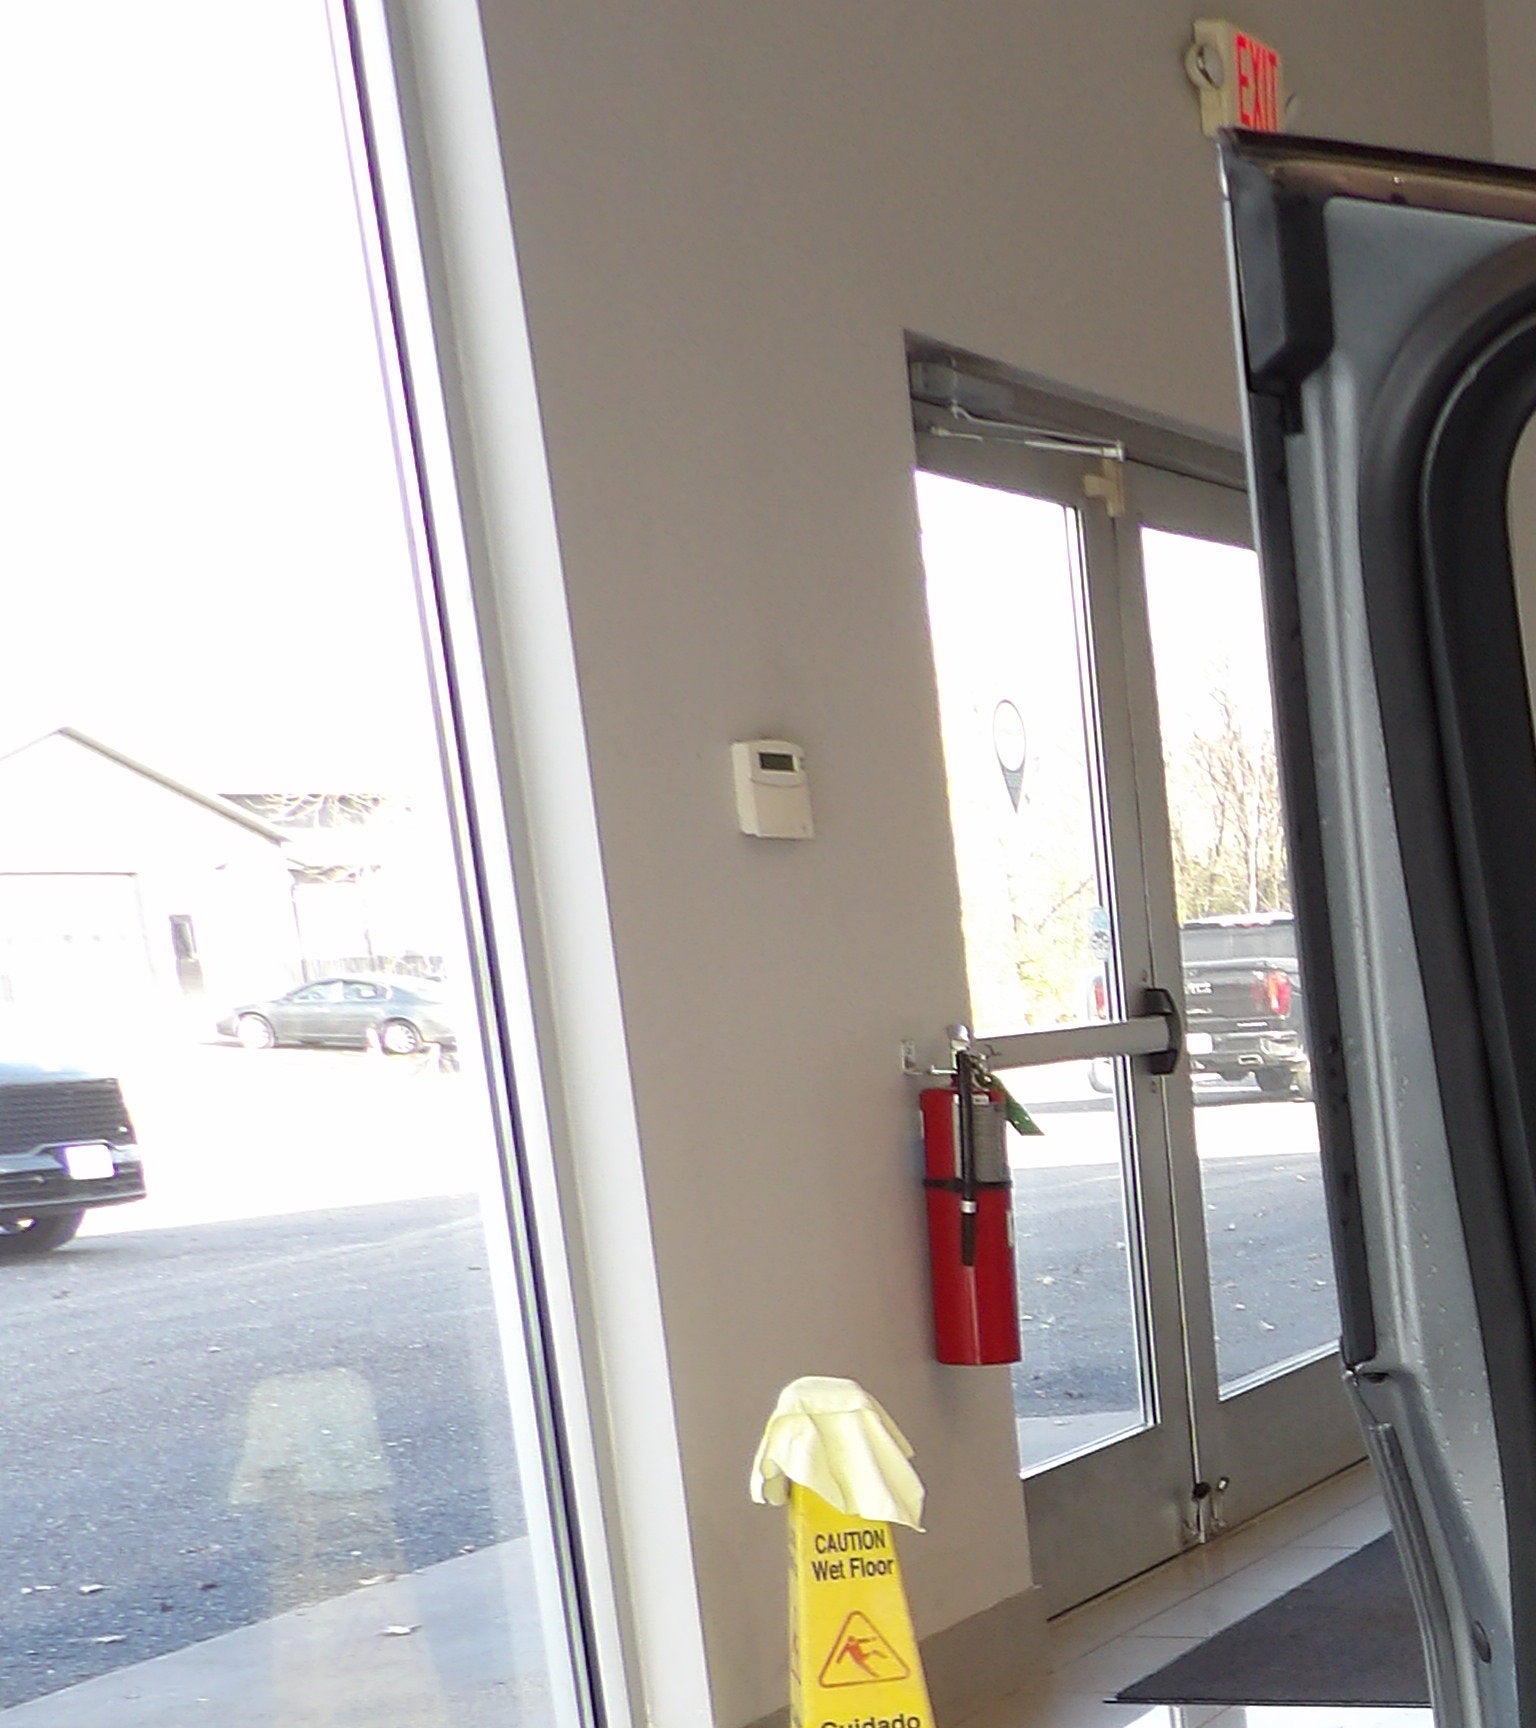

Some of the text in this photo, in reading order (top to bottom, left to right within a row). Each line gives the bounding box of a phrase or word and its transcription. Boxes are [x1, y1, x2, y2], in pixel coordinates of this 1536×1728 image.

[1235, 33, 1278, 132] EXIT
[815, 1529, 886, 1554] CAUTION
[811, 1557, 894, 1581] Wet Floor
